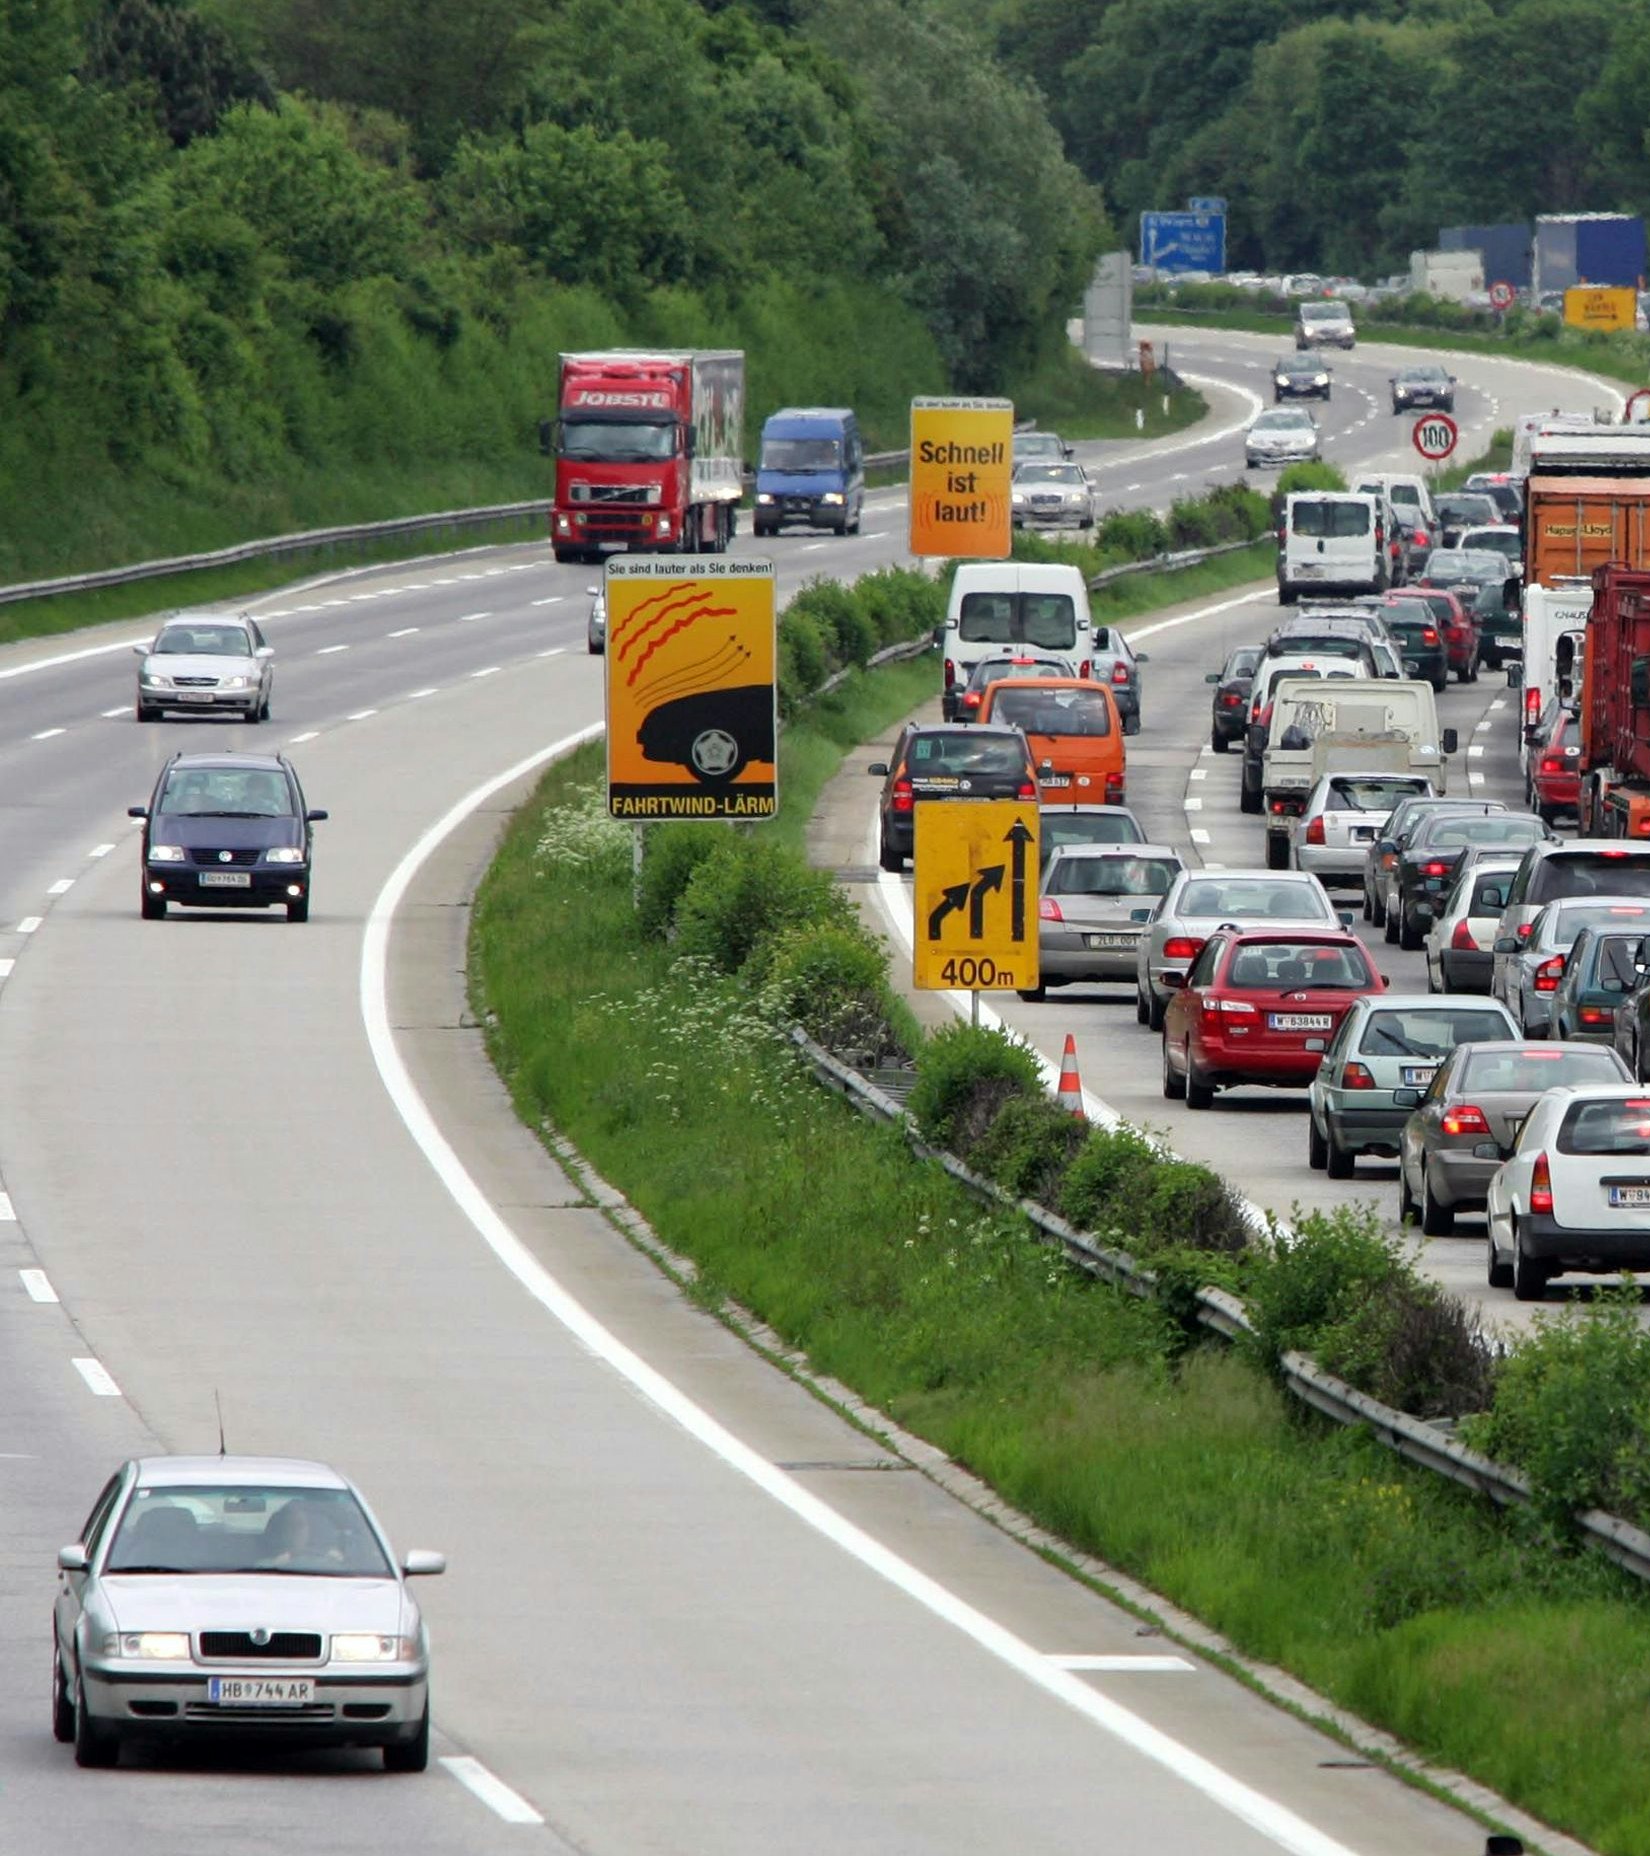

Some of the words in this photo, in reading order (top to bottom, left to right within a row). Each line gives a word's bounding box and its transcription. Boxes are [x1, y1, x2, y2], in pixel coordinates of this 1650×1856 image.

[572, 392, 665, 407] JOBSTL
[1423, 426, 1449, 448] 100
[919, 441, 1004, 464] Schnell
[947, 471, 976, 494] ist
[935, 500, 986, 522] laut!
[608, 563, 625, 574] Sie
[629, 563, 651, 574] sind
[655, 563, 686, 574] lauter
[690, 562, 706, 574] als
[709, 562, 726, 574] Sie
[729, 562, 773, 573] denken!
[612, 793, 774, 815] FAHRTWIND-LÄRM
[222, 1682, 242, 1698] HB
